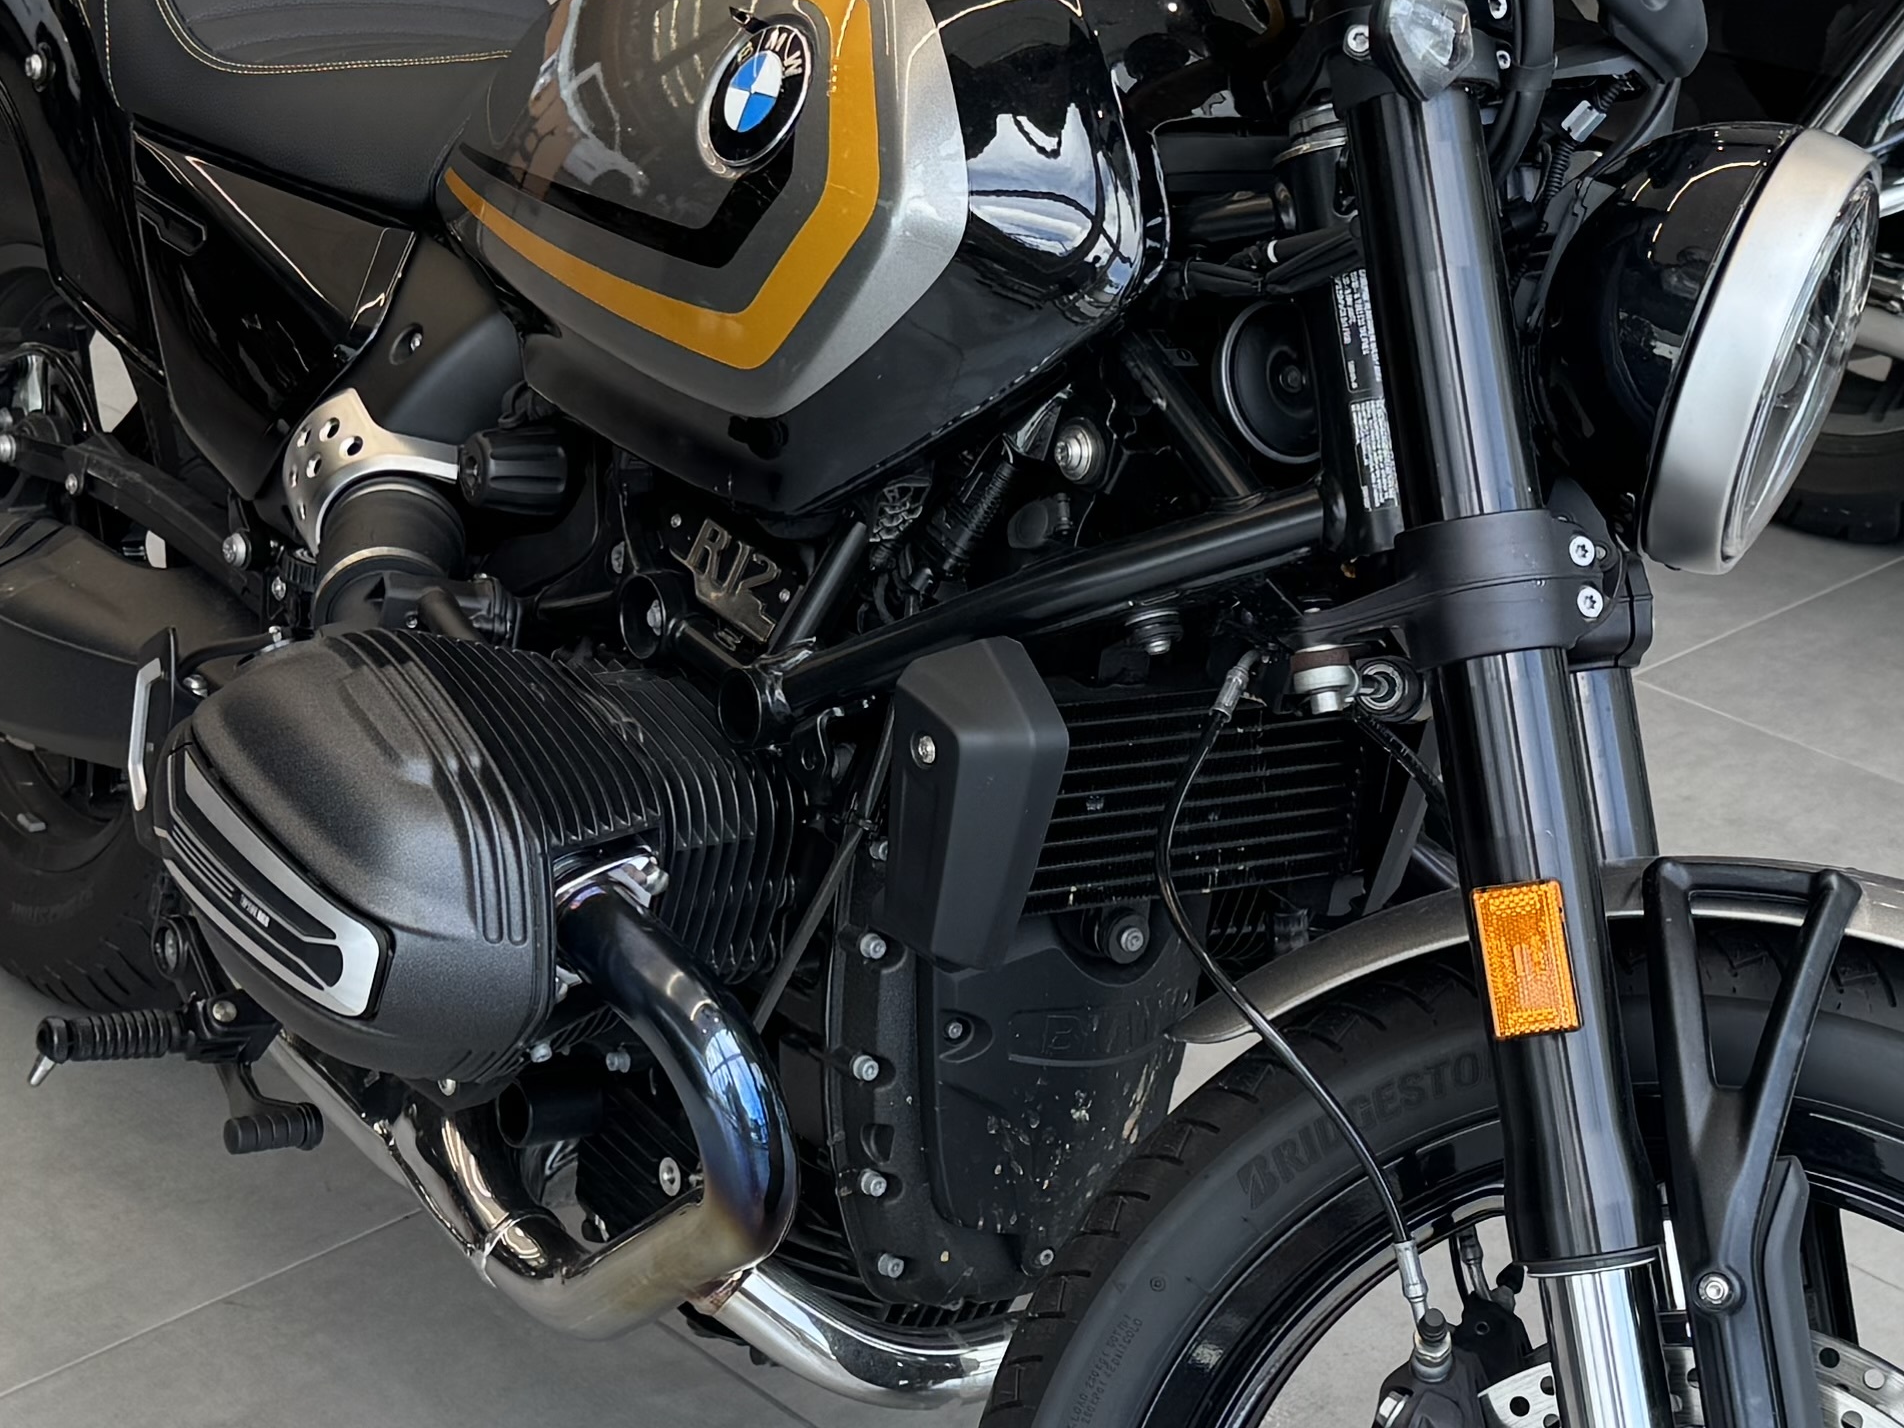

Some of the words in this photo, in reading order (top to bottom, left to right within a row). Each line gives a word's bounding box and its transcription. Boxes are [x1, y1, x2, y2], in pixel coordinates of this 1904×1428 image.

[736, 28, 803, 79] BMW
[686, 517, 783, 598] R12
[1236, 1048, 1492, 1211] BRIDGESTO
